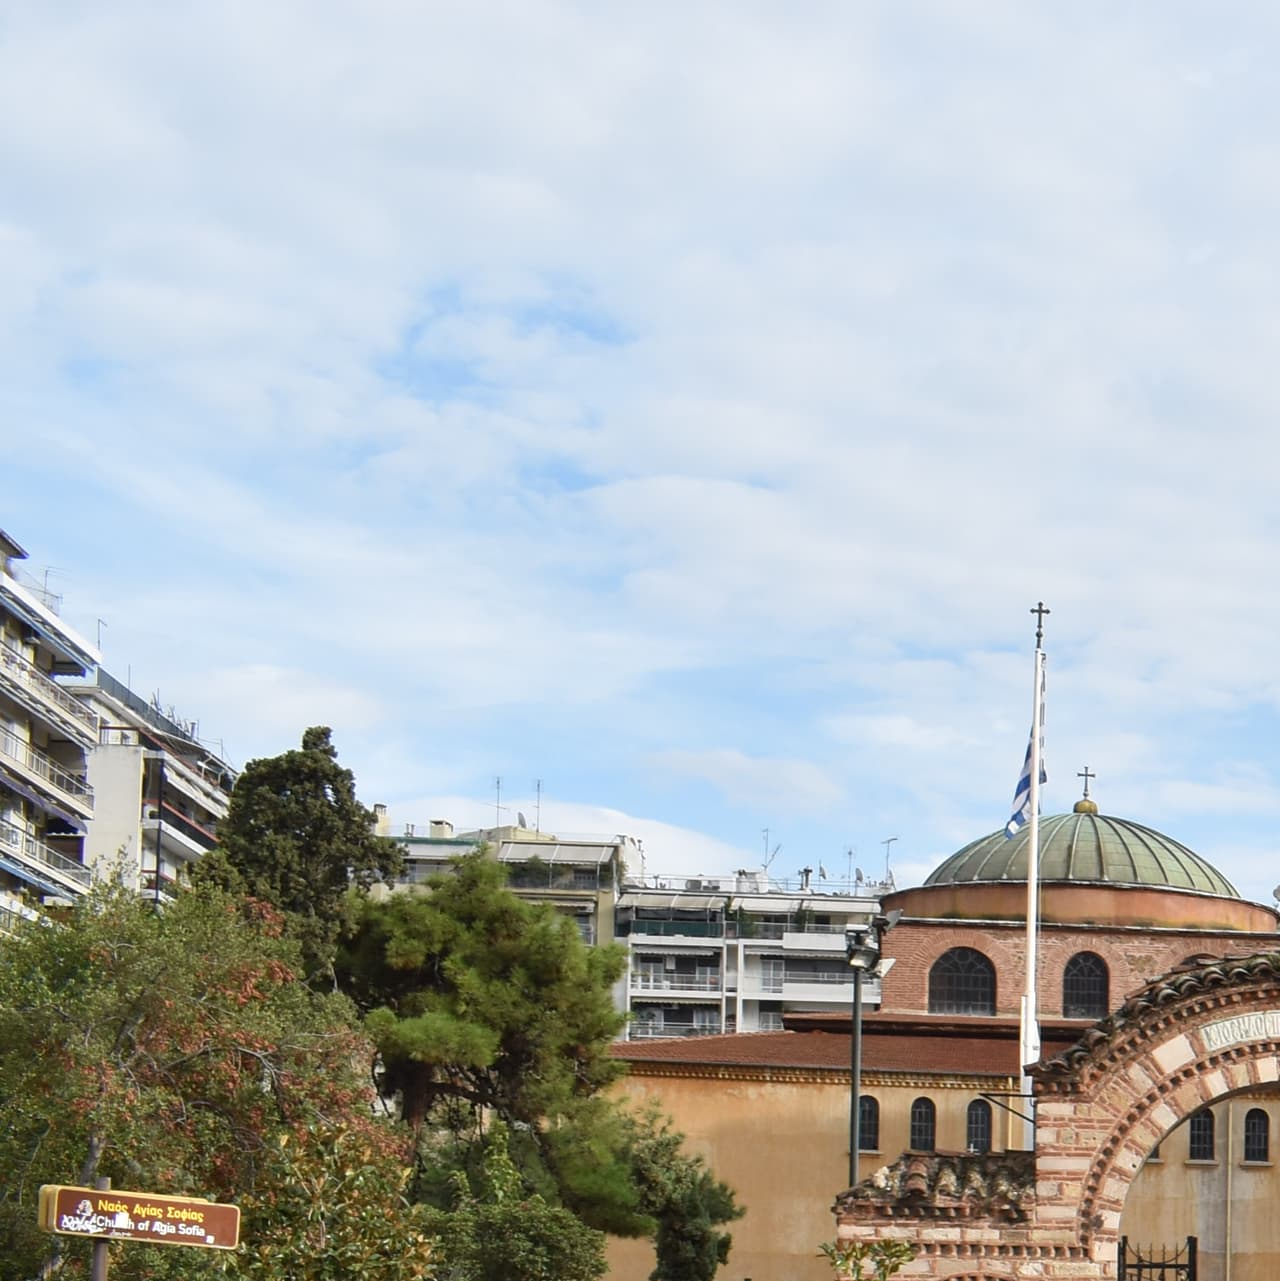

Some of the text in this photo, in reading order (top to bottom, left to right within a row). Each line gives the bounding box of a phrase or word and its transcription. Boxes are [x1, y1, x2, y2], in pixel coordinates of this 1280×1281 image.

[98, 1200, 204, 1223] Ναός Αγίας Σοφίας
[138, 1219, 150, 1231] of
[152, 1221, 176, 1236] Agia
[178, 1223, 206, 1237] Sofia
